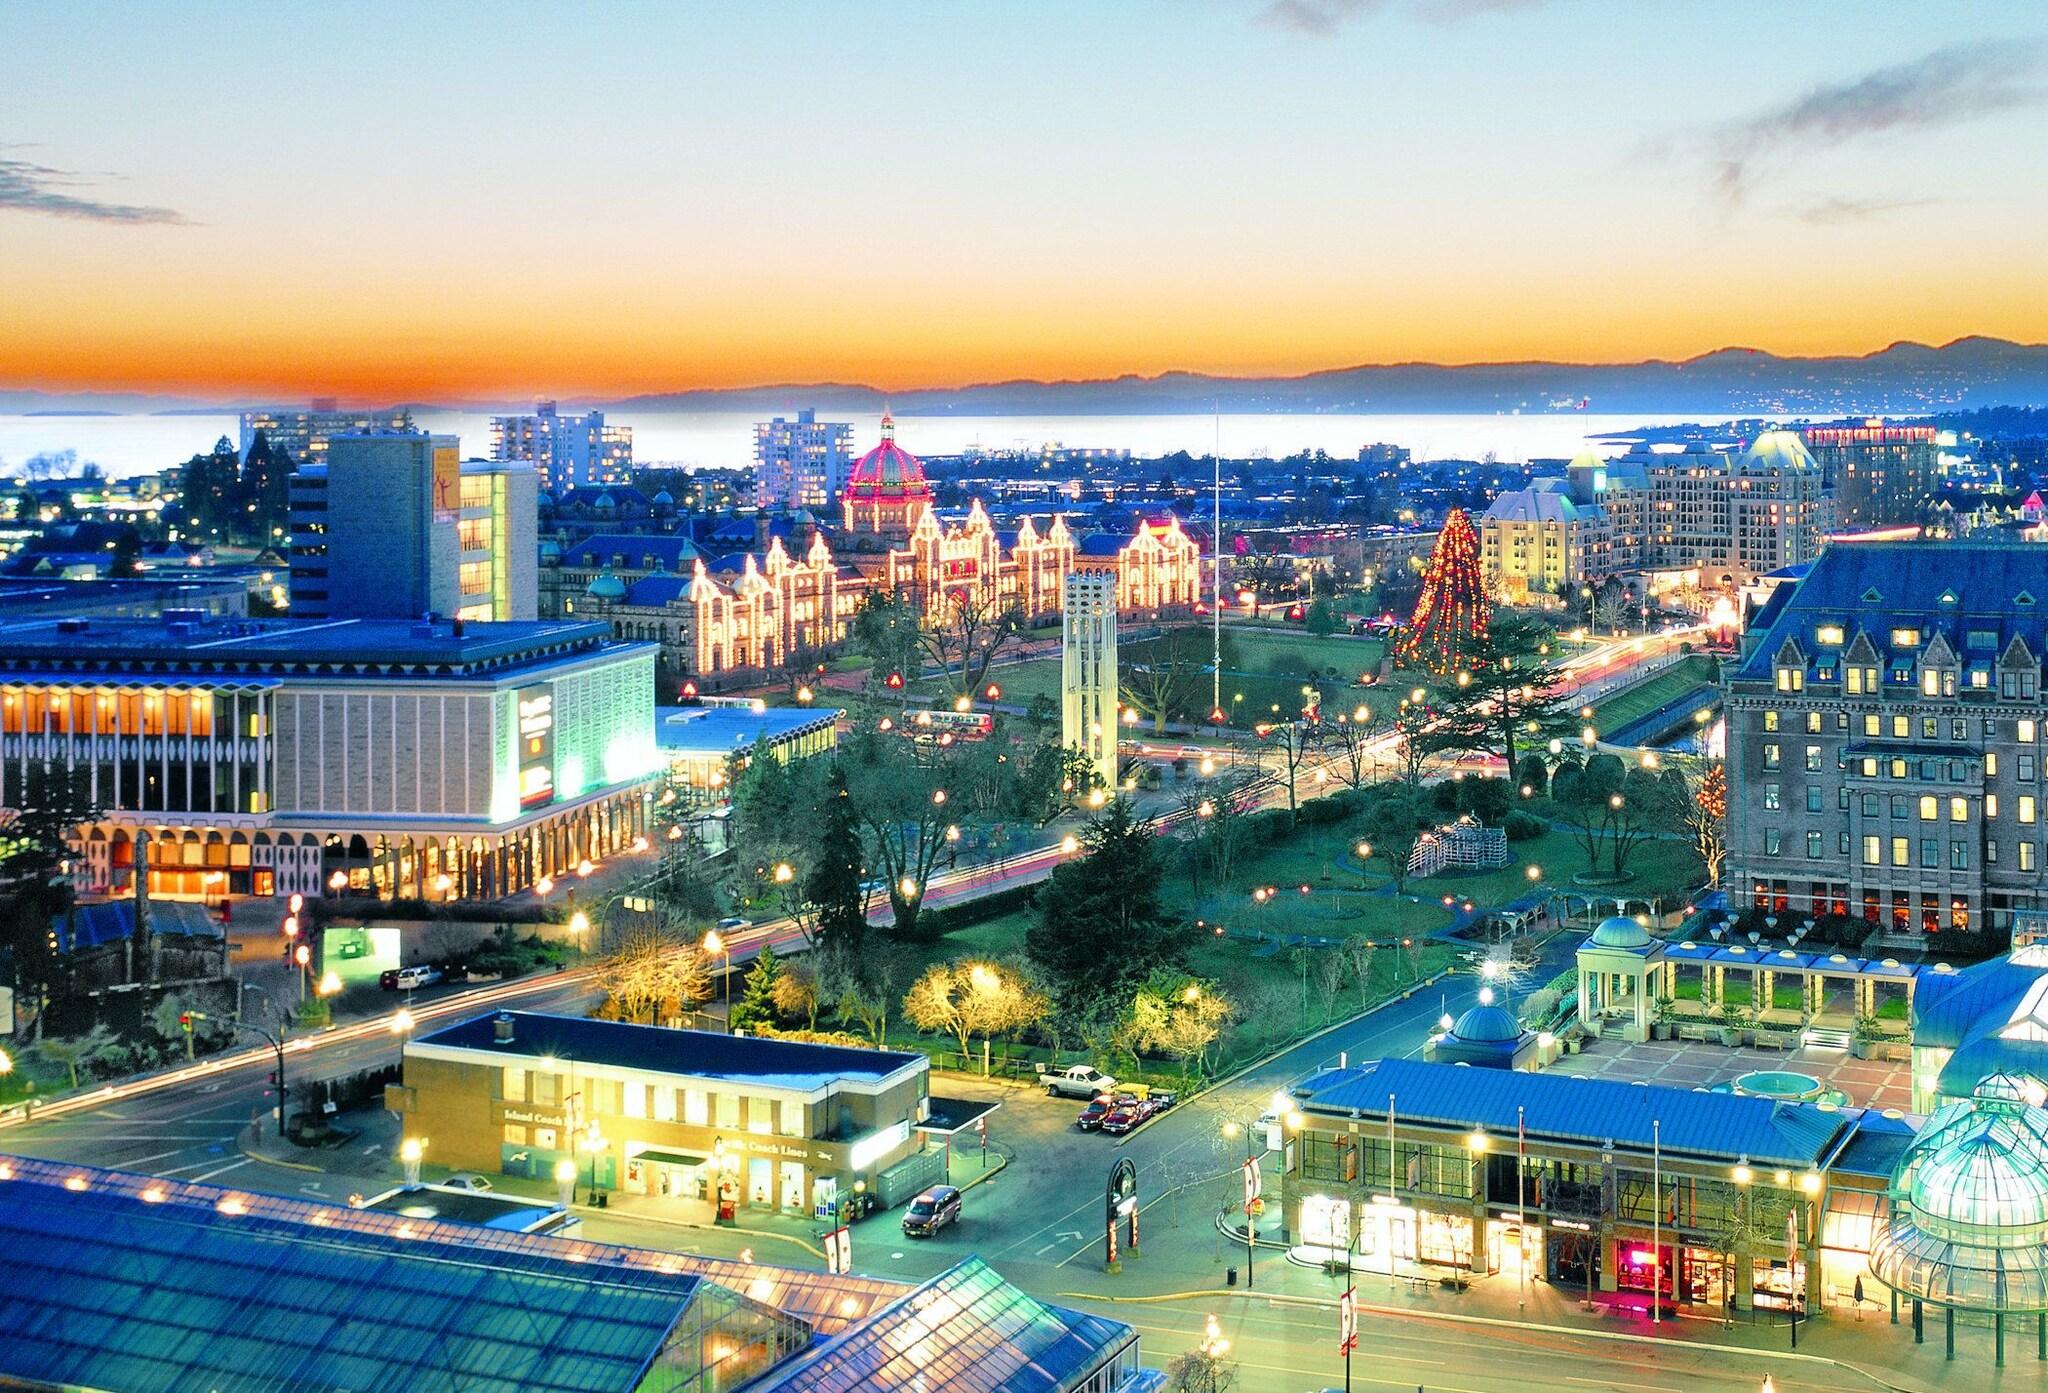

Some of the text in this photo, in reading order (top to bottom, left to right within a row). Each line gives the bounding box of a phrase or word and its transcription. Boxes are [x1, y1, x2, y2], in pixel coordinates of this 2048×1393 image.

[504, 1109, 533, 1122] Island
[534, 1113, 563, 1126] Coach
[749, 1141, 779, 1154] Coach
[781, 1145, 808, 1158] Lines
